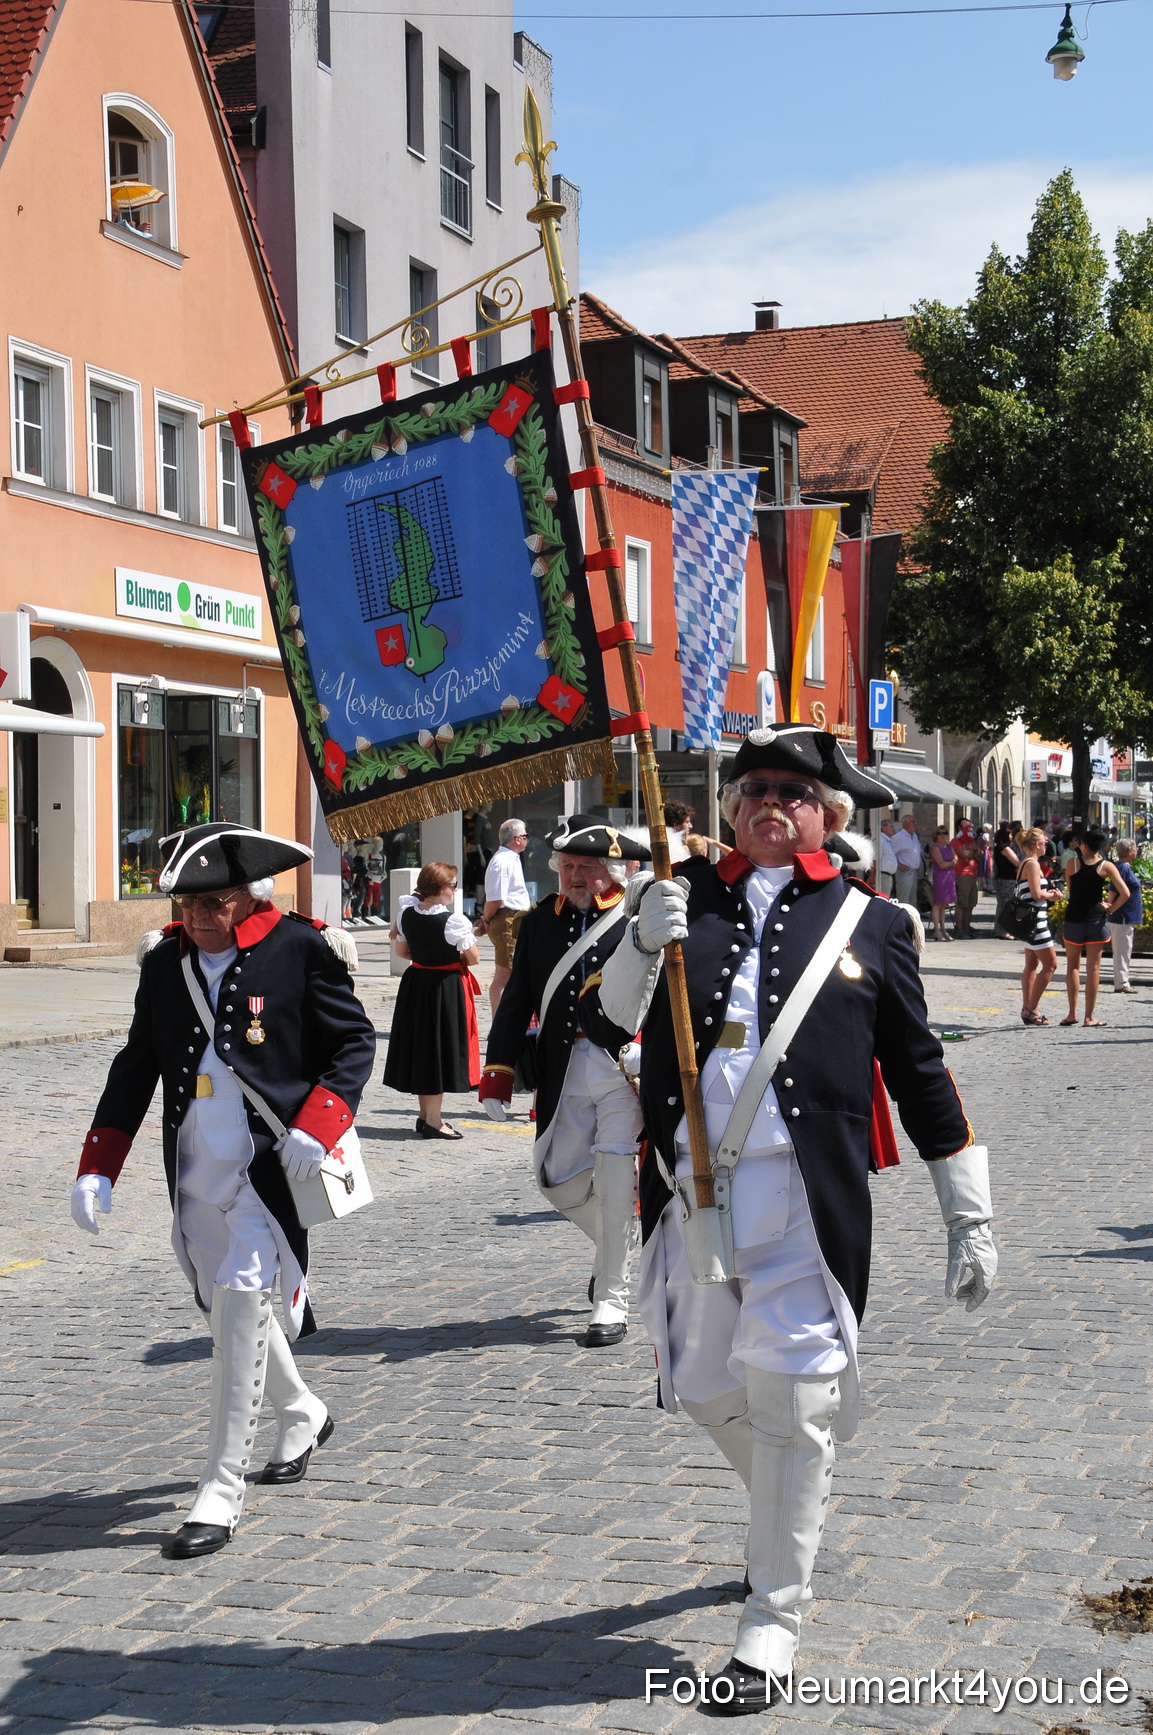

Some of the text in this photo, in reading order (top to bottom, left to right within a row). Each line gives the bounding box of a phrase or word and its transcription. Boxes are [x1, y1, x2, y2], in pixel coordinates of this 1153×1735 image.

[413, 454, 438, 472] 1988
[126, 579, 255, 629] Blumen Grün Punkt
[875, 687, 888, 723] P
